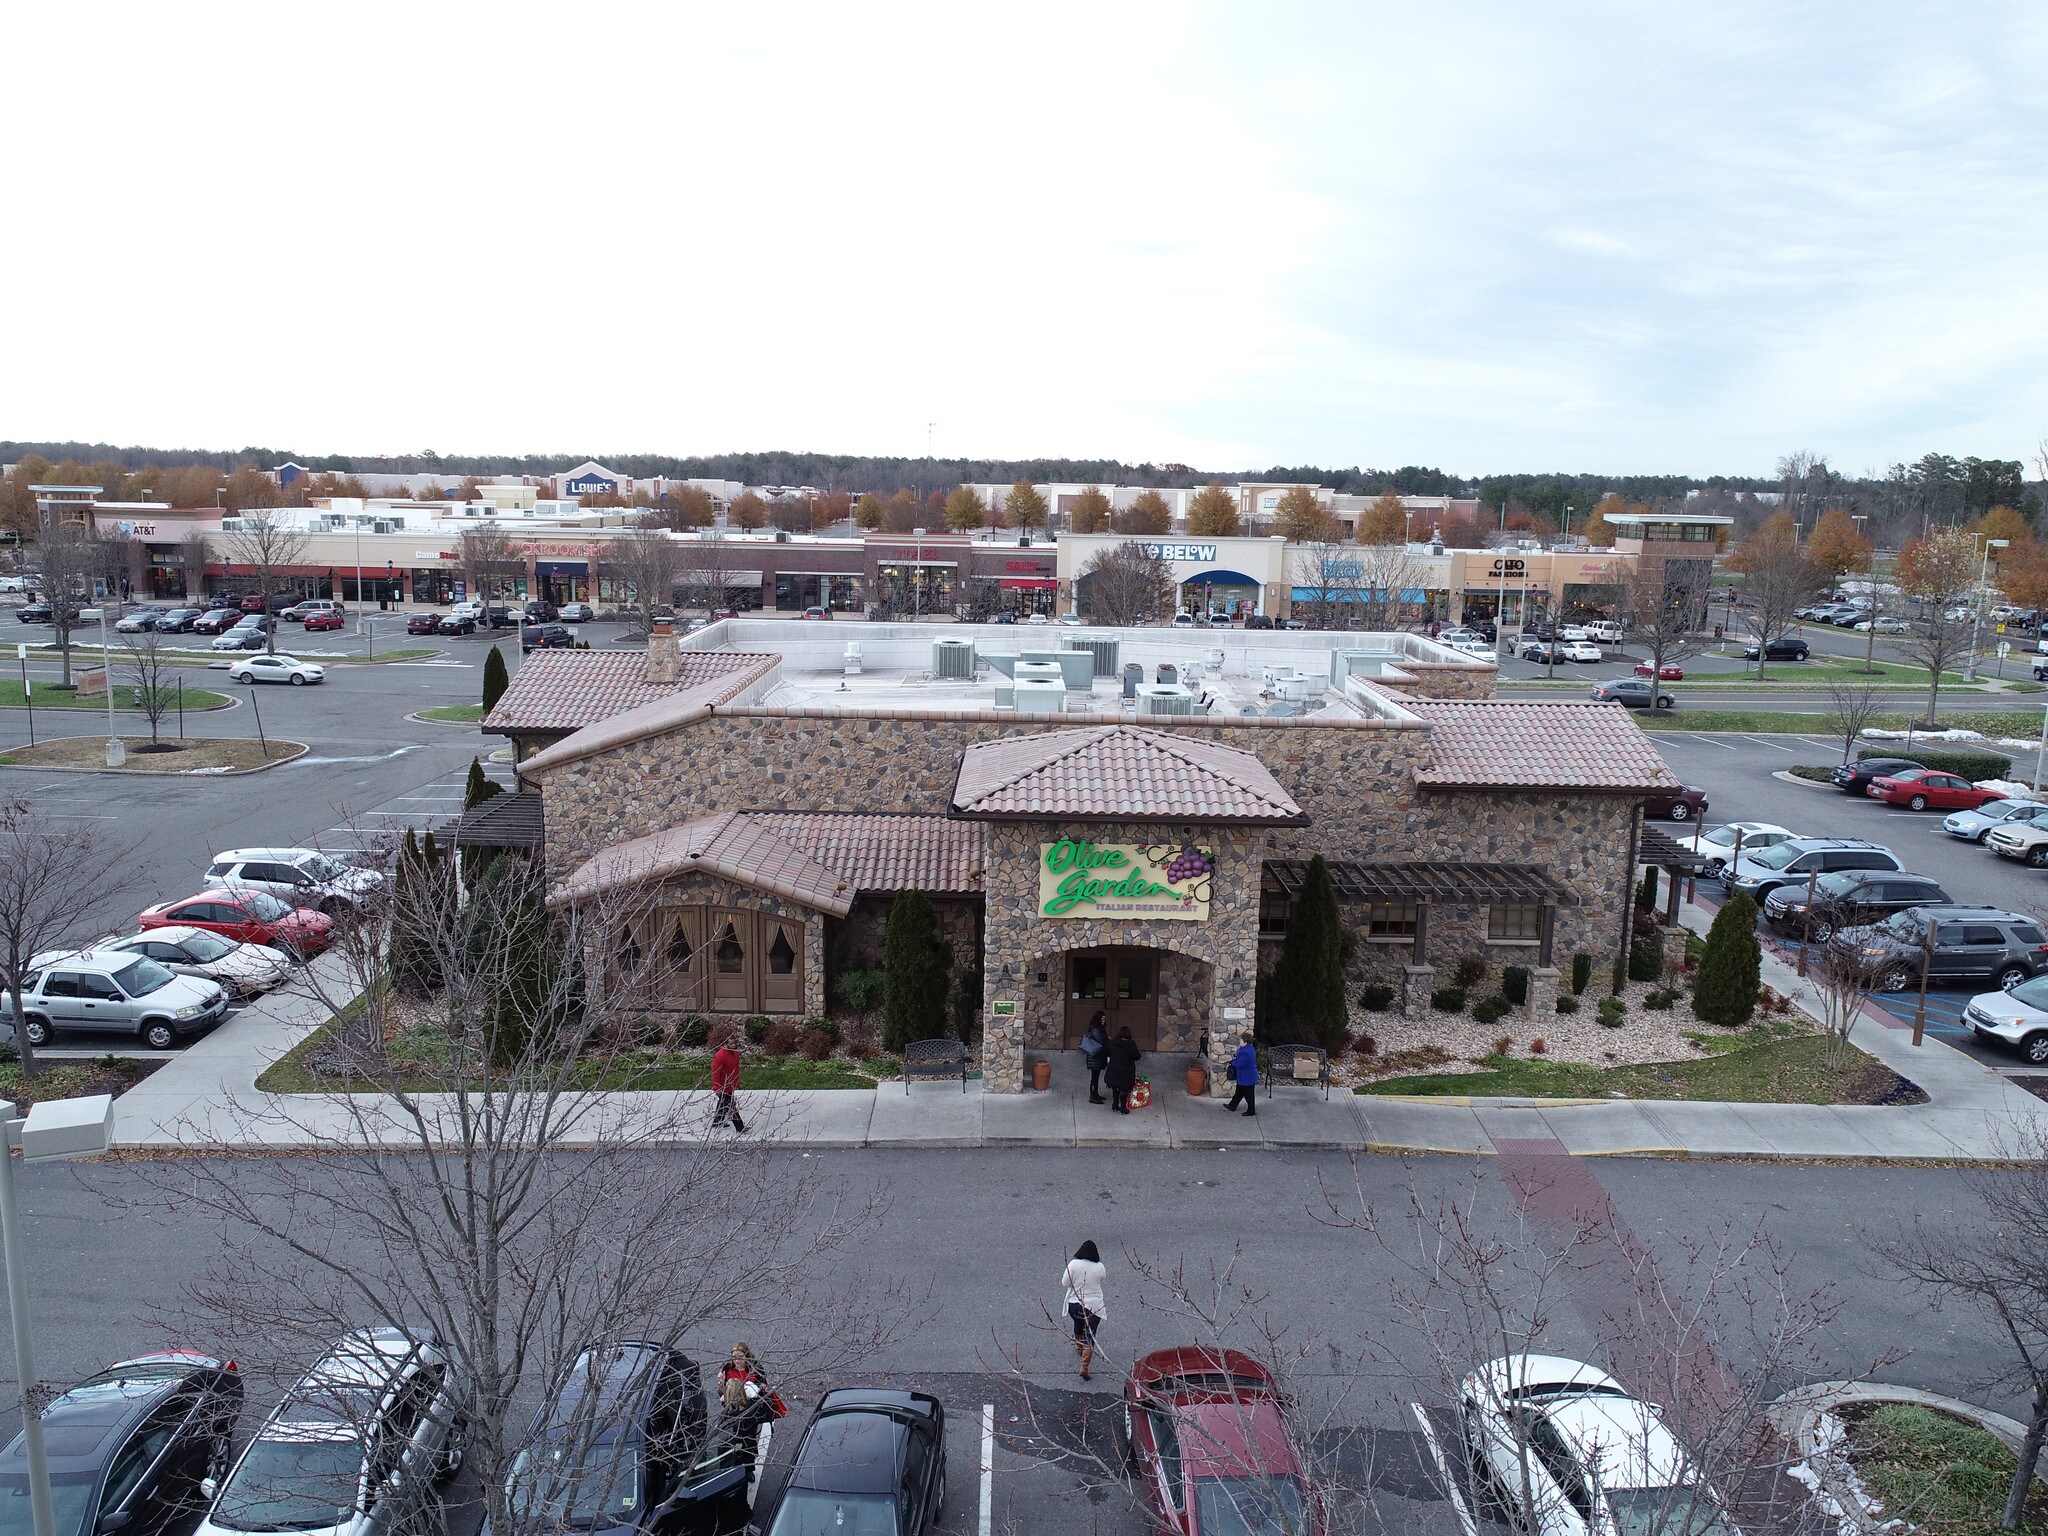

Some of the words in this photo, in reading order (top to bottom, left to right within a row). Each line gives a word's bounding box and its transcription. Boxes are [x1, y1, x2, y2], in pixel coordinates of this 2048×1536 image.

[571, 482, 611, 493] LOWE'S
[133, 526, 156, 535] AT&T
[1163, 545, 1216, 560] BELOW
[1007, 561, 1040, 571] SALLY
[1045, 839, 1129, 874] Olive
[1044, 866, 1182, 915] Garden
[1096, 903, 1133, 911] ITALIAN
[1135, 904, 1199, 912] RESTAURANT
